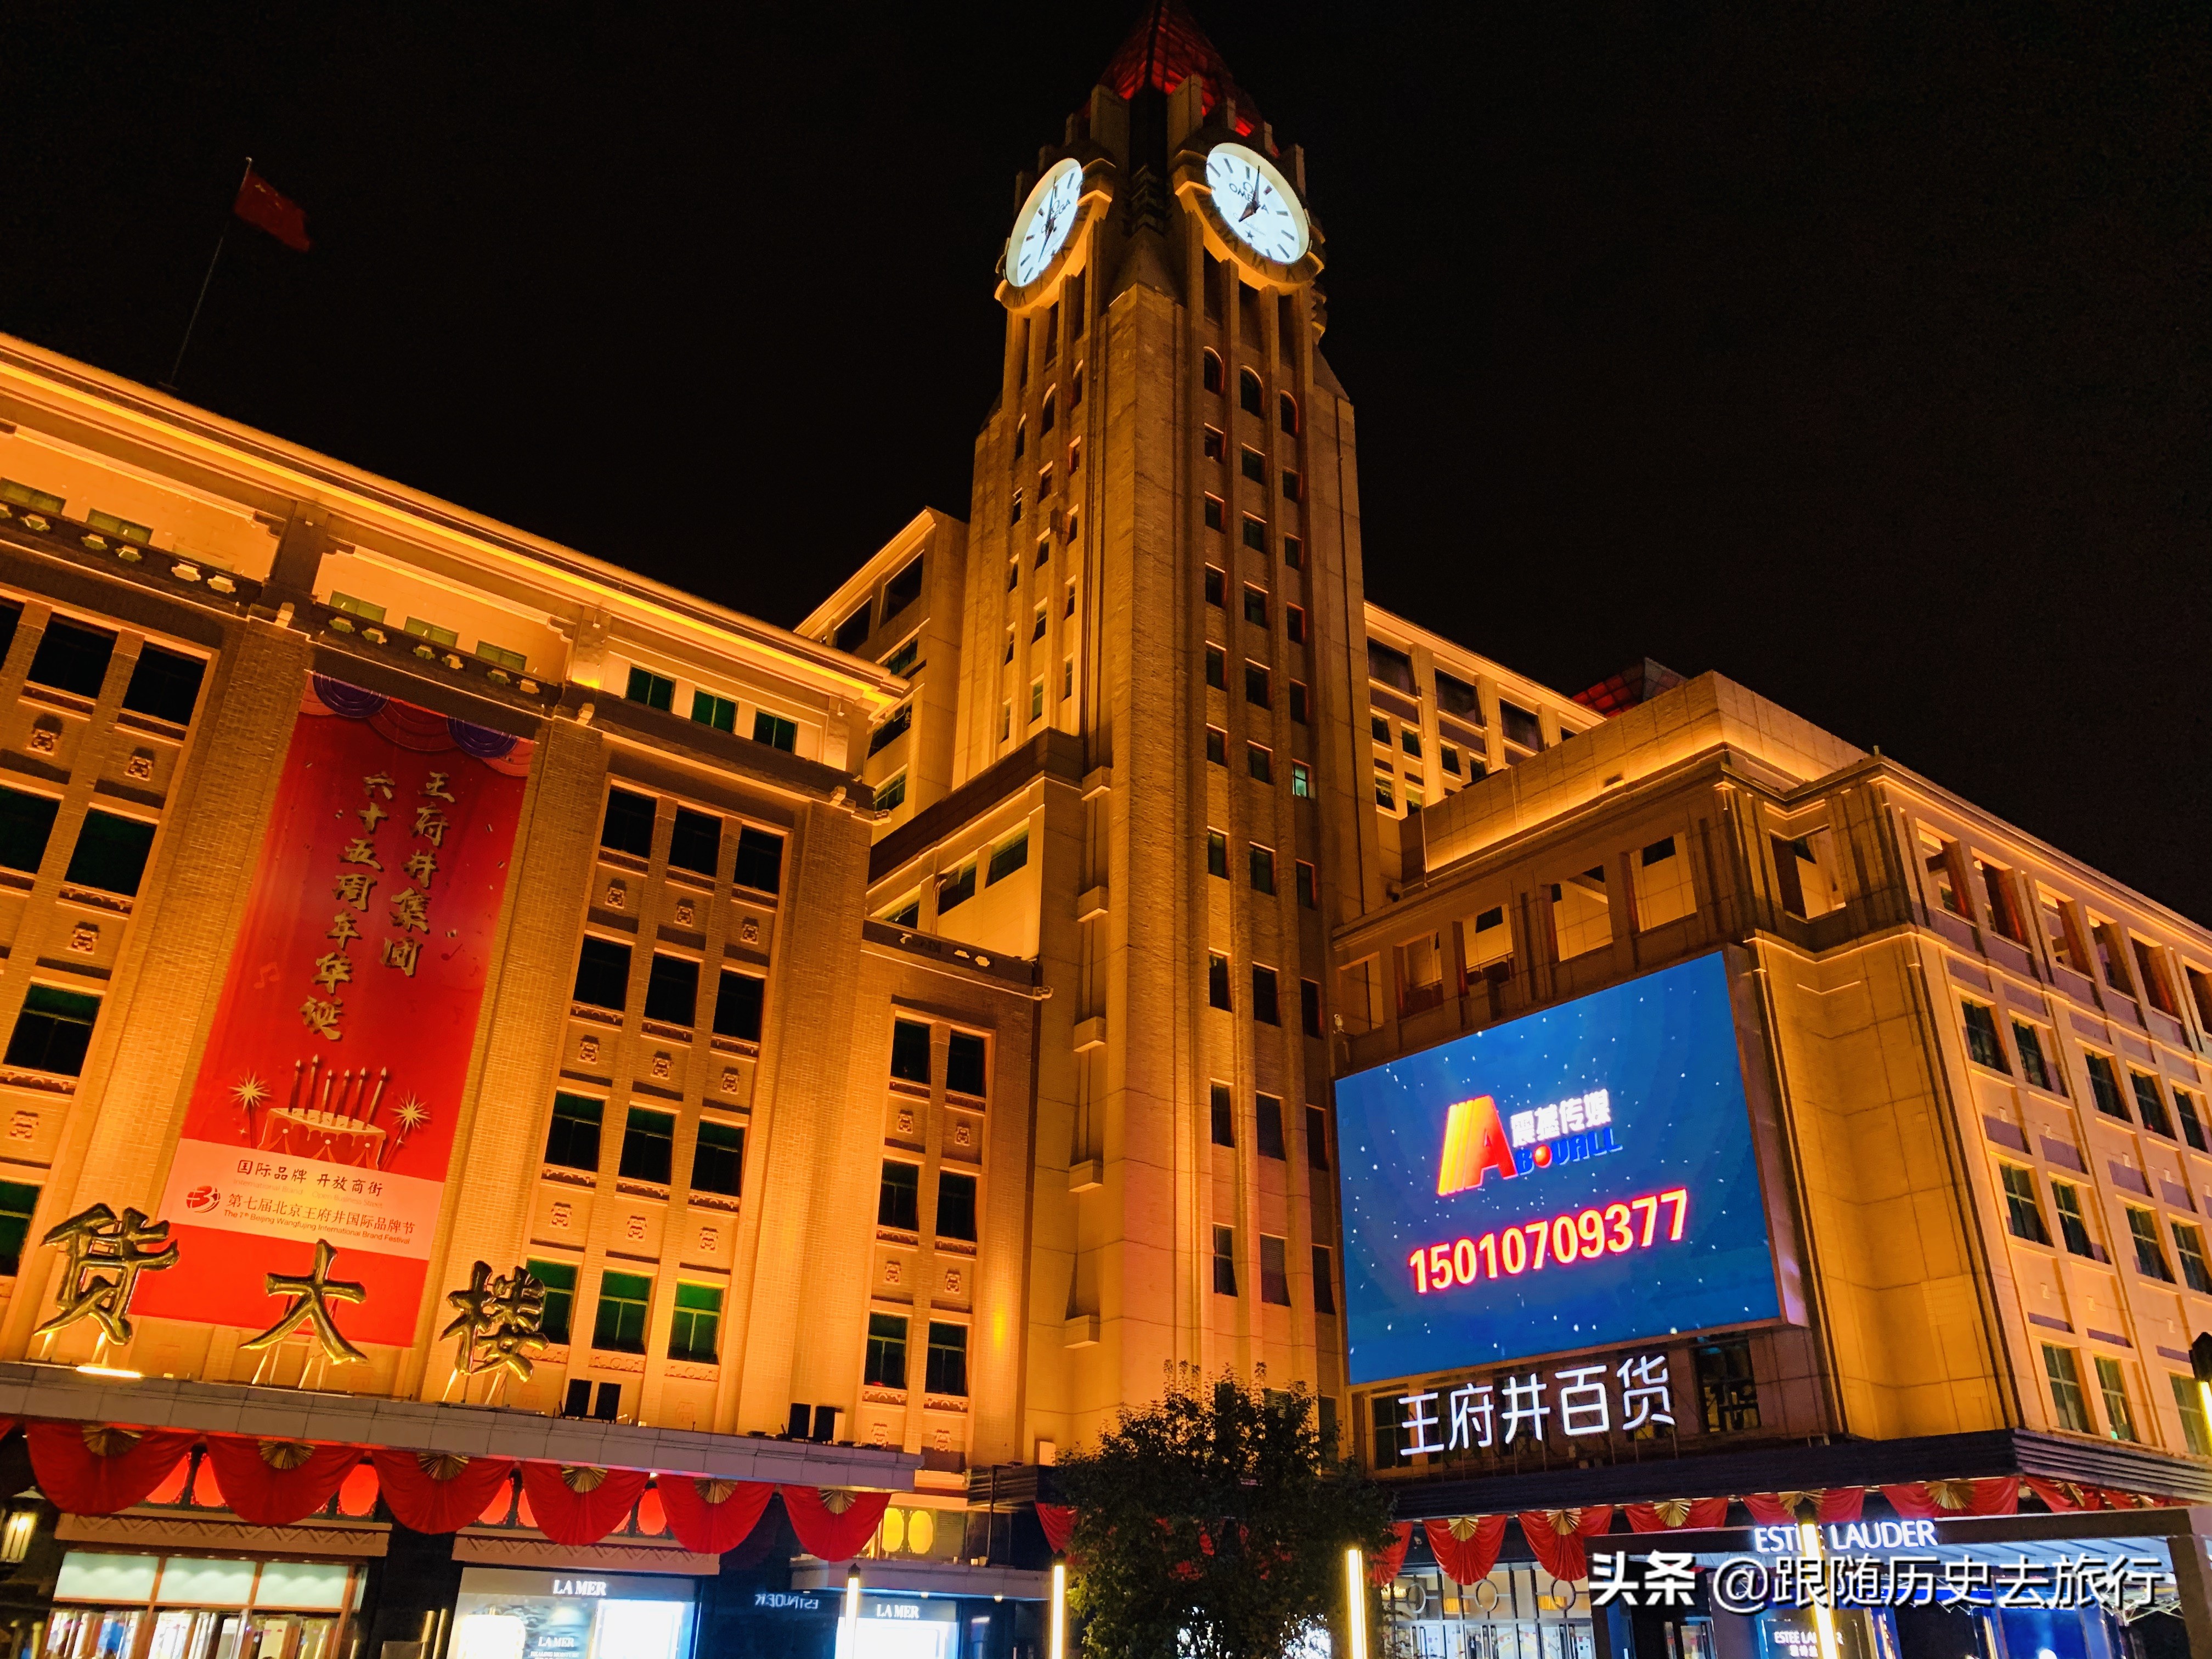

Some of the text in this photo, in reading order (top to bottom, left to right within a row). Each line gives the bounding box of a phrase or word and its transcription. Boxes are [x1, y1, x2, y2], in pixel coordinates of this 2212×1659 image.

[1229, 183, 1269, 215] OMEA
[299, 771, 396, 1041] 六十五周年华诞
[238, 1160, 383, 1197] 国际品牌 开放商街
[224, 1210, 238, 1218] The
[250, 1214, 275, 1224] Beijing
[276, 1218, 317, 1231] Wangfujing
[318, 1224, 360, 1237] International
[362, 1231, 383, 1240] Brand
[384, 1234, 410, 1245] Festival
[226, 1193, 415, 1234] 第七届北京王府井国际品牌节
[1409, 1188, 1689, 1295] 15010709377
[1398, 1355, 1675, 1456] 王府井百货
[1831, 1520, 1938, 1550] LAUDER
[552, 1579, 606, 1595] LA MER
[876, 1604, 919, 1619] LA MER
